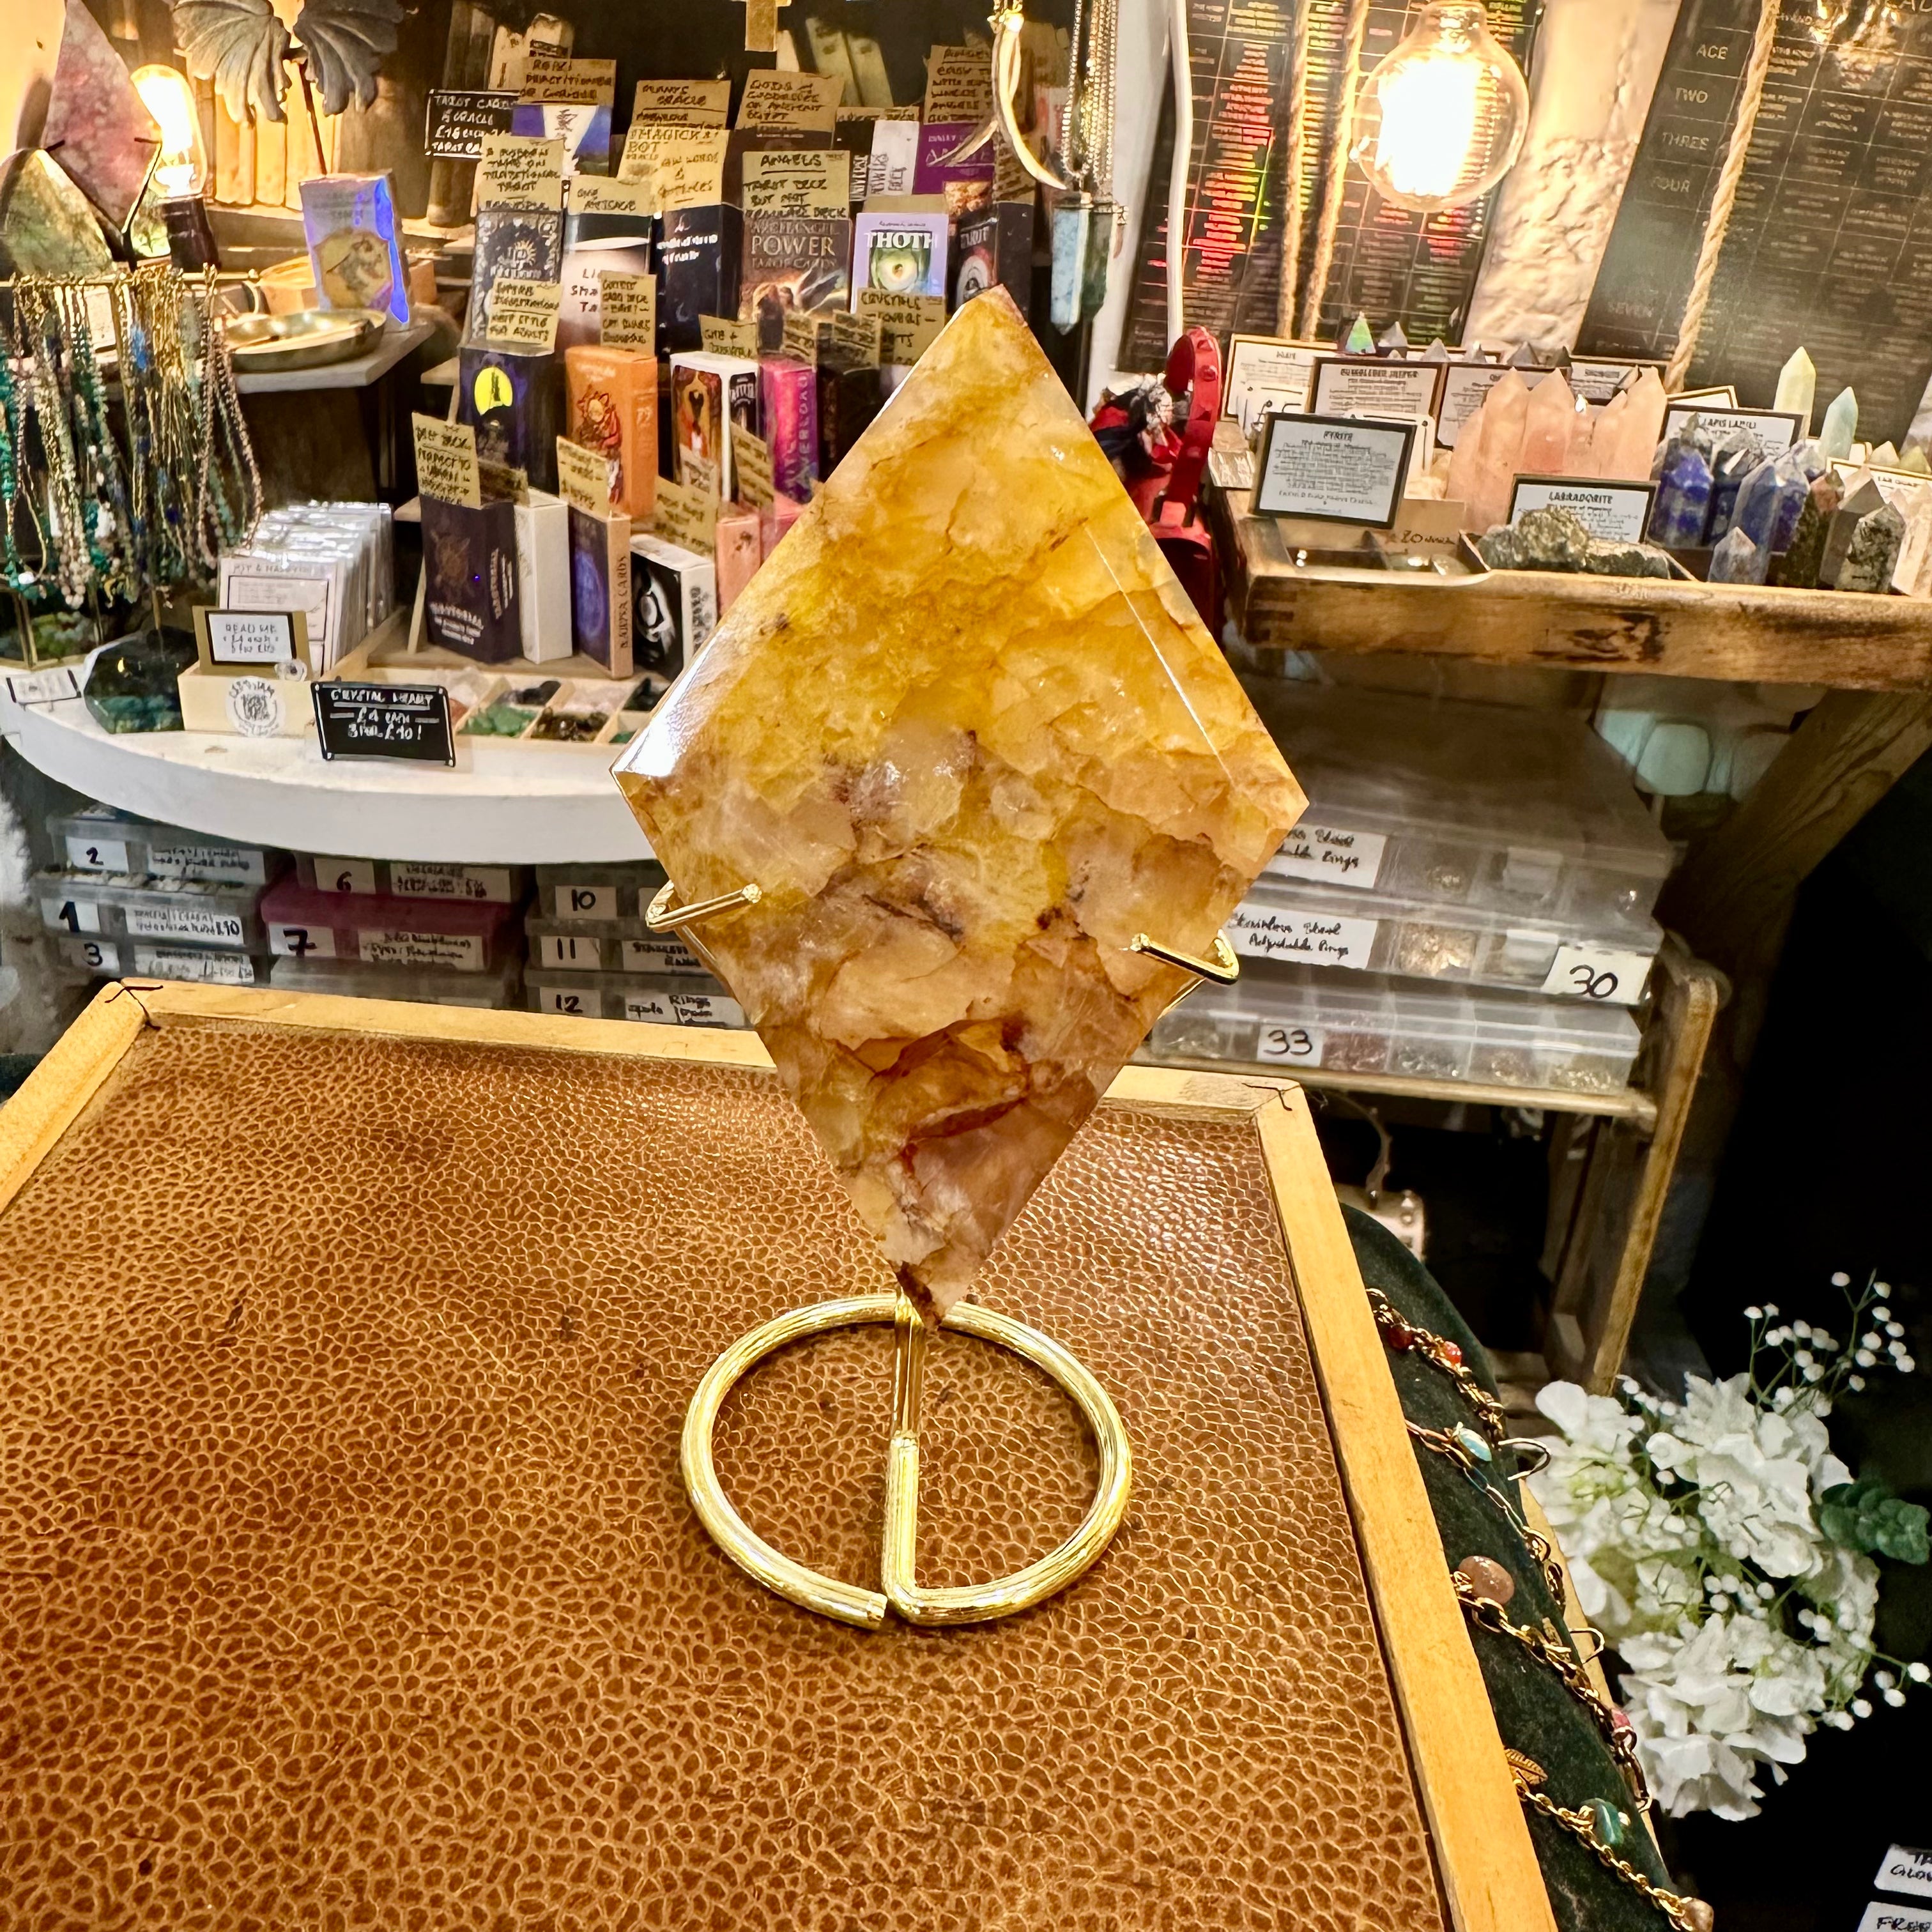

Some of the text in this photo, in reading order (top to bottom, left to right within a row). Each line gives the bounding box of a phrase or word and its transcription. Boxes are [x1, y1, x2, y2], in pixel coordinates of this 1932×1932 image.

[1696, 43, 1728, 61] ACE
[1675, 88, 1708, 103] TWO
[1662, 132, 1709, 151] THREE
[760, 153, 822, 167] ANGELS
[751, 234, 836, 257] POWER
[864, 231, 938, 250] THOTH
[1548, 491, 1614, 504] LABRADORITE
[617, 555, 629, 597] CARDS
[226, 624, 256, 633] READ
[330, 688, 386, 703] CRYSTAL
[86, 847, 103, 866] 2
[336, 870, 353, 892] 6
[571, 888, 595, 912] 10
[59, 900, 80, 933] 1
[282, 928, 317, 957] 7
[556, 937, 578, 960] 11
[83, 942, 103, 967] 3
[1568, 963, 1619, 999] 30
[555, 994, 583, 1014] 12
[1263, 1028, 1314, 1057] 33
